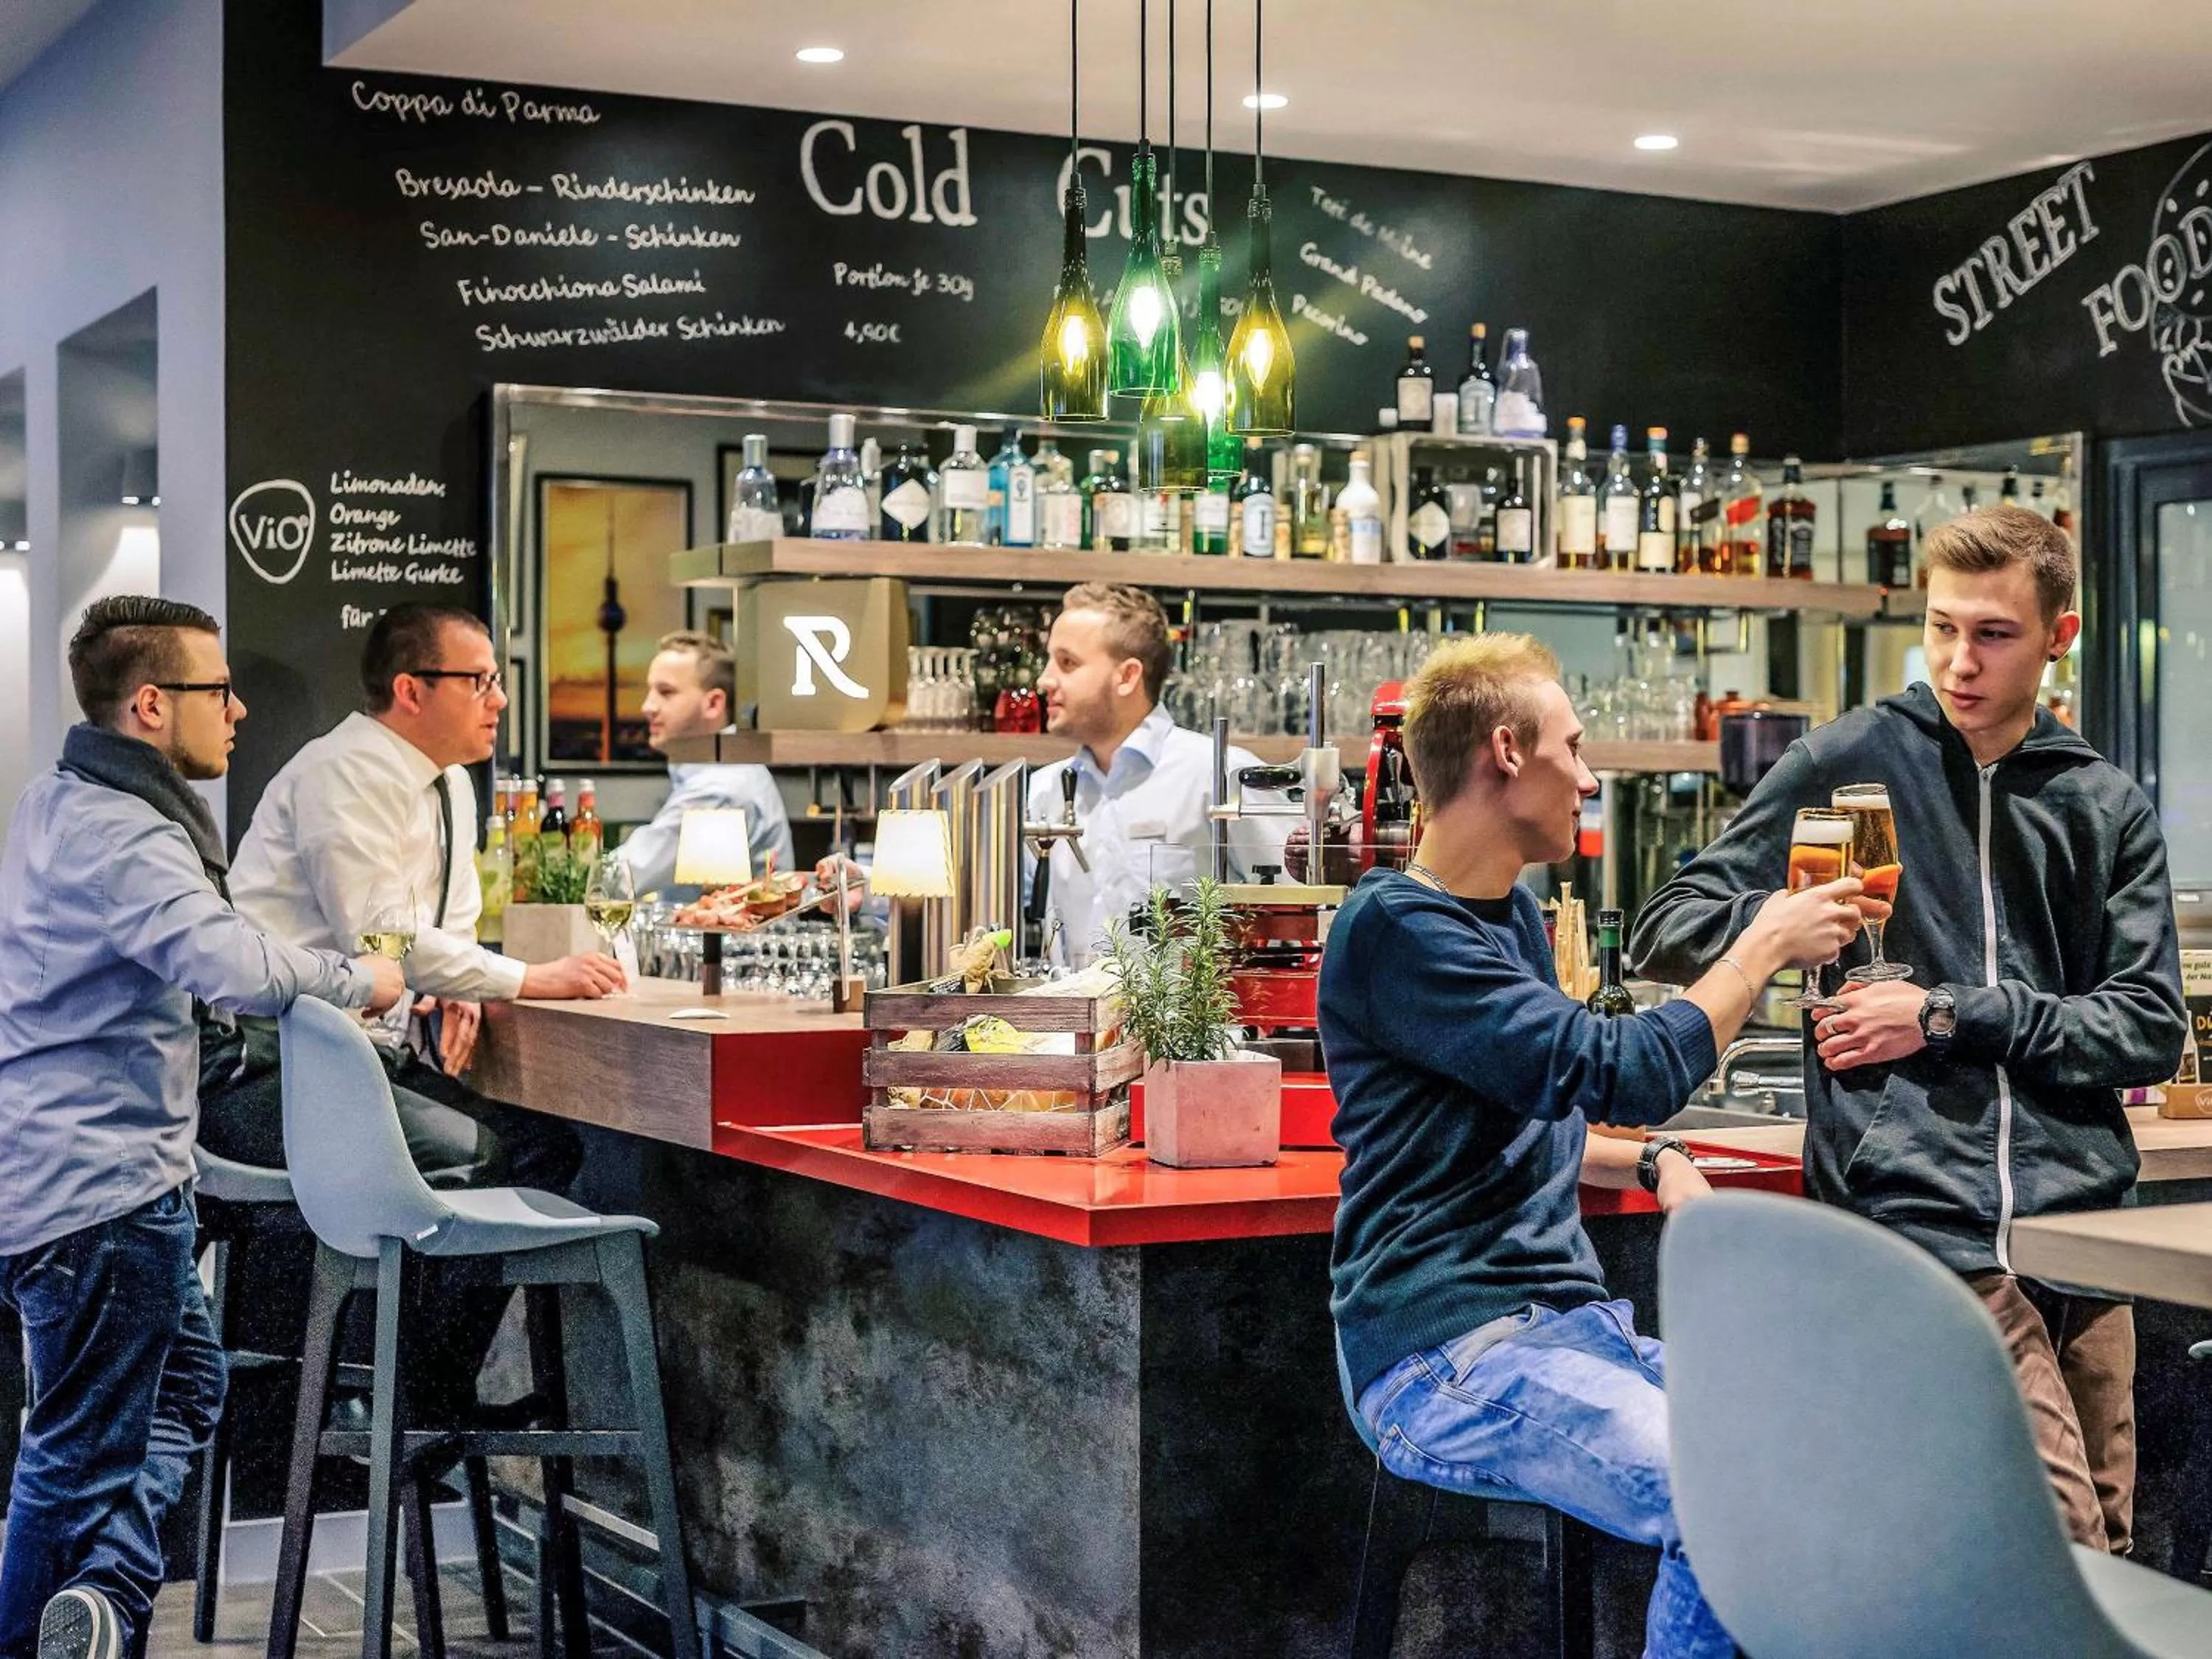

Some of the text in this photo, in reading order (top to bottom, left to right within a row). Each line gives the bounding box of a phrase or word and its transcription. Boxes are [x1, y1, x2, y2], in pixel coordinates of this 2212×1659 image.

[352, 80, 601, 125] Coppa di Parma
[394, 167, 522, 201] Bresaola
[551, 172, 757, 206] Rinderschinken
[800, 120, 978, 227] Cold
[420, 220, 599, 249] San-Daniele
[625, 222, 742, 250] Schinken
[1933, 160, 2100, 347] STREET
[622, 269, 707, 296] Salami
[833, 262, 975, 302] Portion je 30g
[2081, 205, 2212, 358] FOOD
[475, 311, 786, 352] Schwarzwälder Schinken
[329, 502, 401, 532] Orange
[330, 532, 477, 558] Zitrone Limette
[330, 559, 465, 585] Limette Gurke
